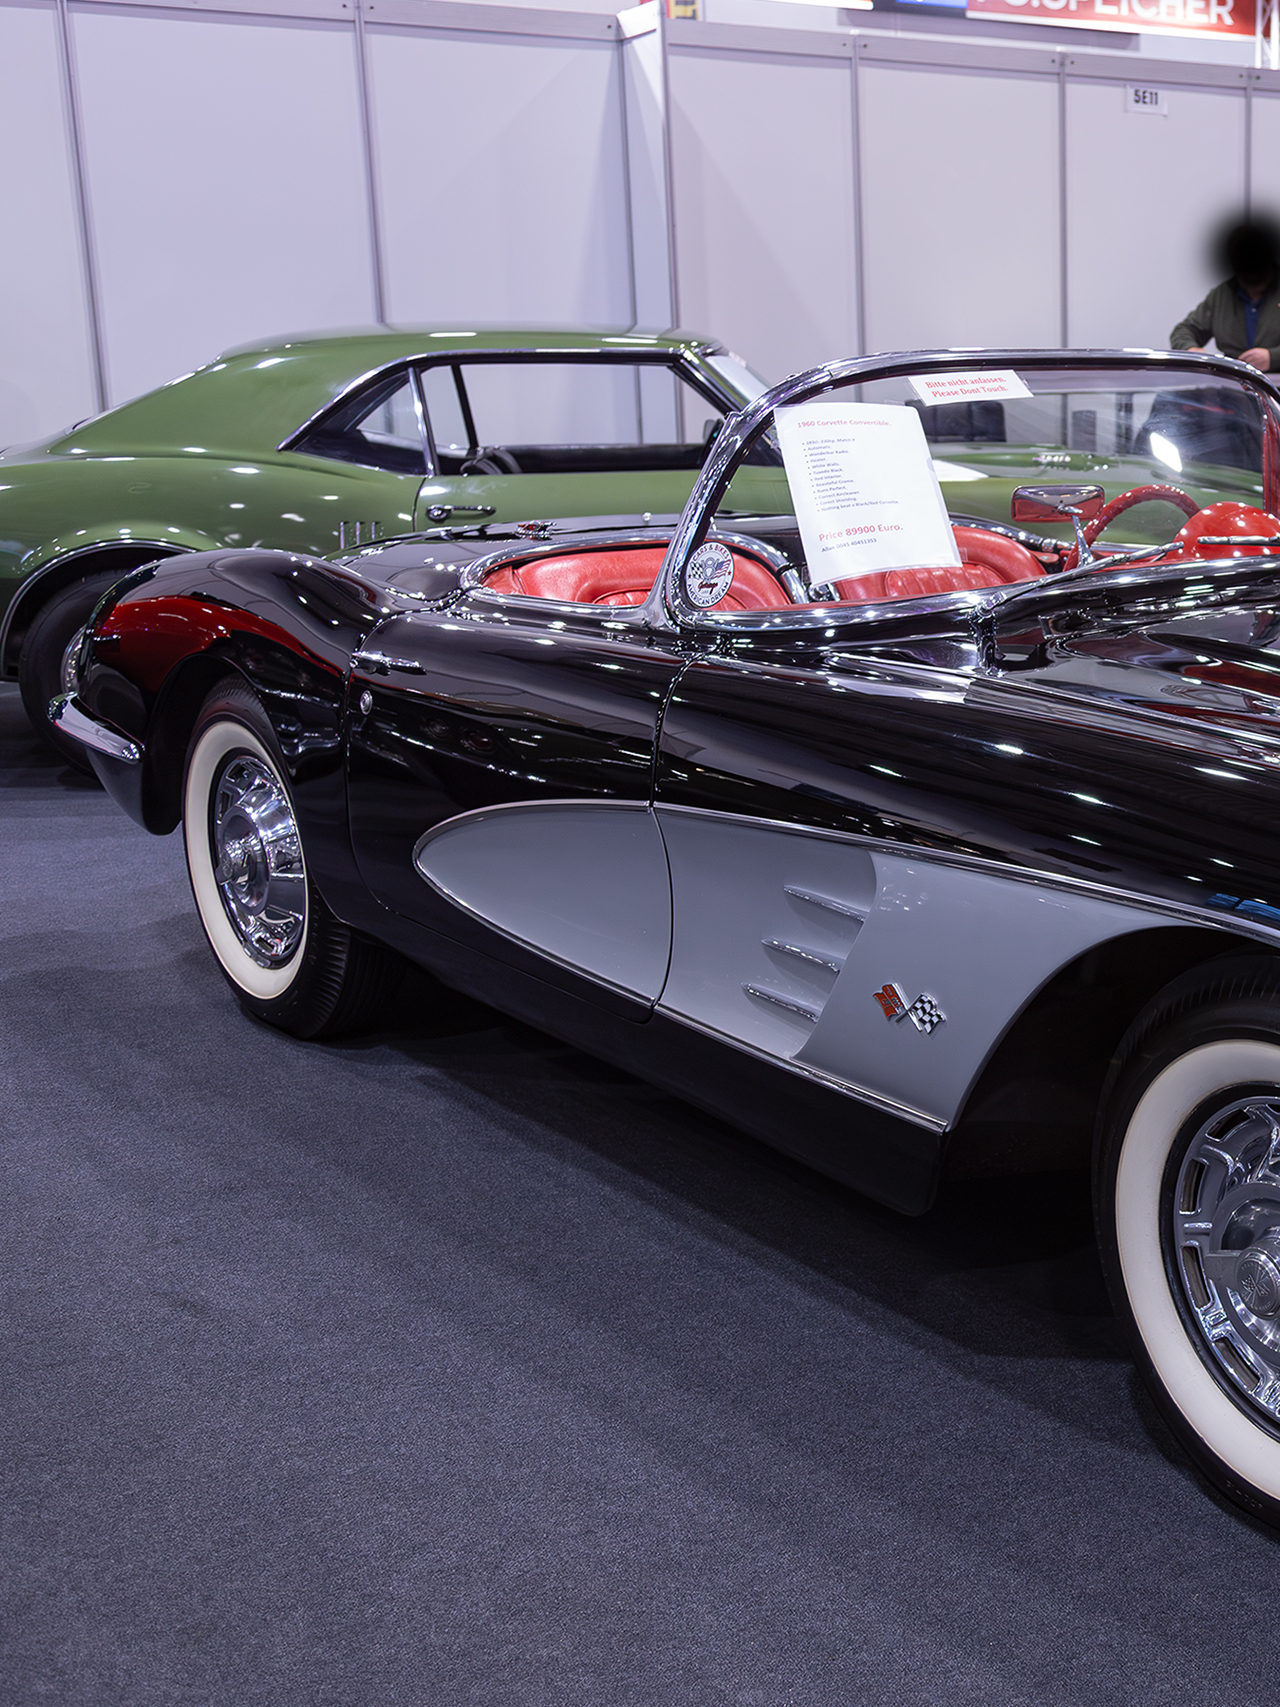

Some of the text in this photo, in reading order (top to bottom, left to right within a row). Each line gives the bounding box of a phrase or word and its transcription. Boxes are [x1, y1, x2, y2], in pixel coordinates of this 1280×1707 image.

[1133, 89, 1159, 106] 5E11
[925, 376, 1007, 389] Bitte nicht anfassen.
[931, 385, 1009, 398] Please Dont Touch.
[797, 419, 892, 428] 1960 Corvette Convertible.
[818, 523, 904, 542] Price 89900 Euro.
[693, 546, 708, 561] CARS
[714, 544, 729, 559] BIKES
[821, 545, 836, 553] Allan
[687, 582, 729, 605] AMERICAN DREAM
